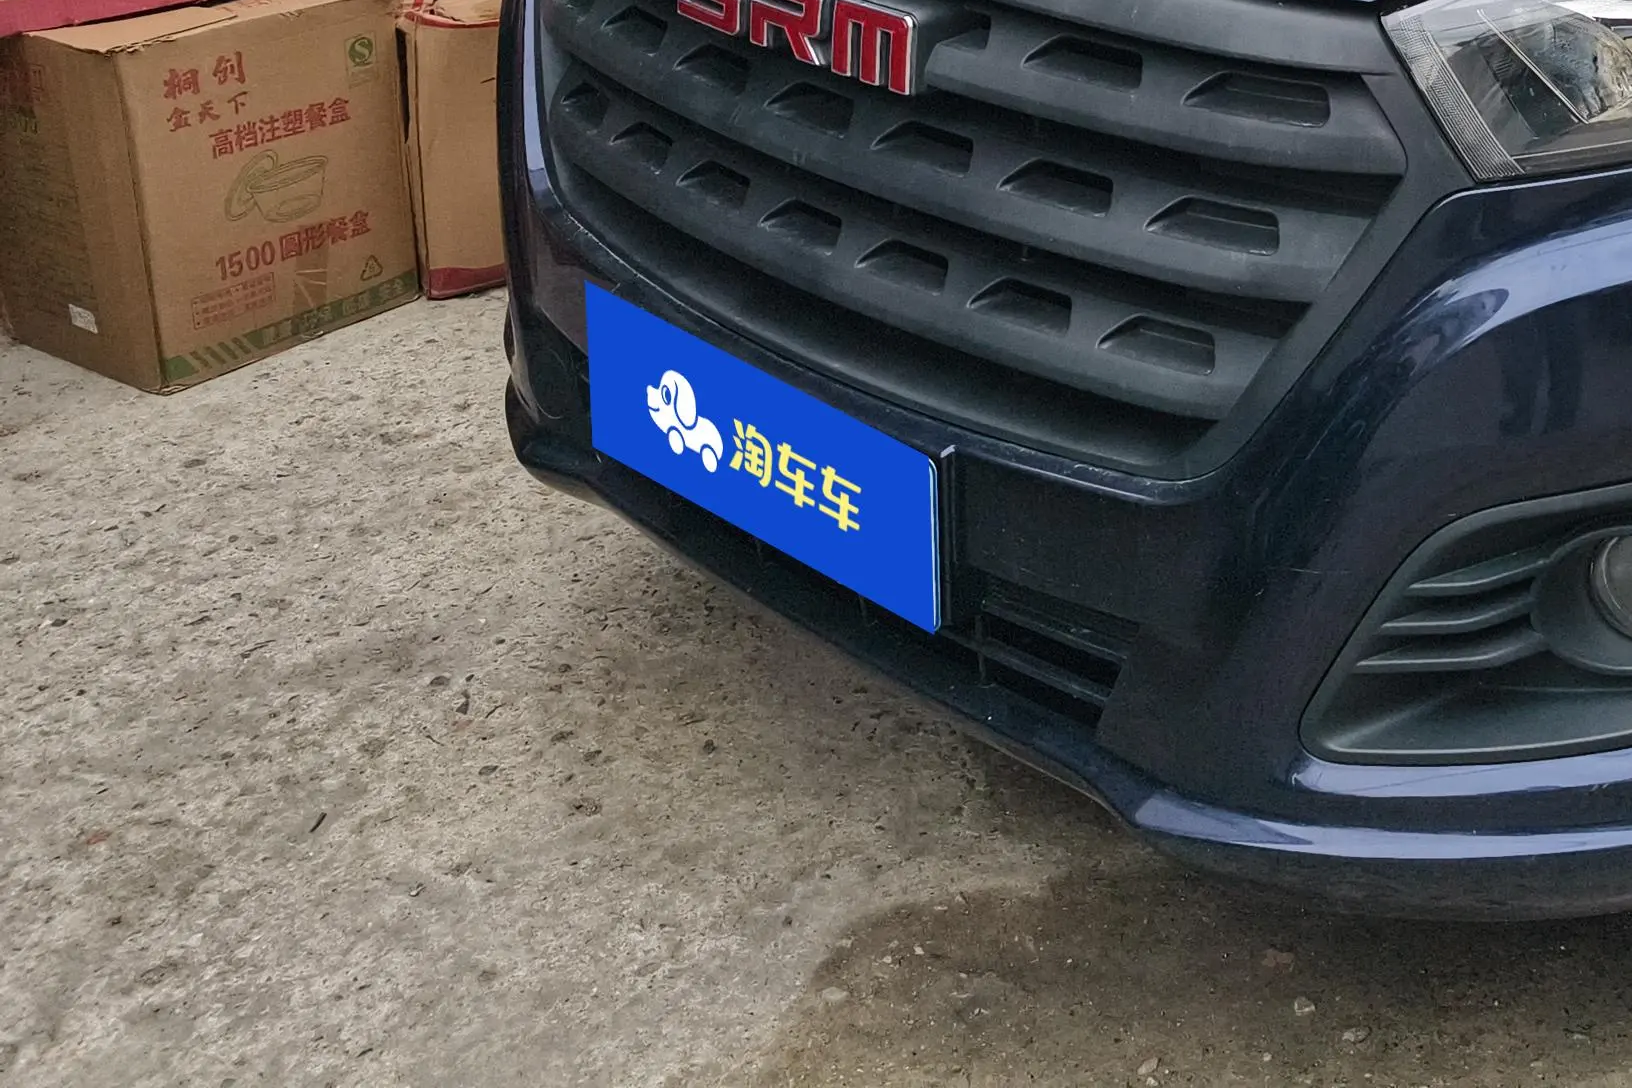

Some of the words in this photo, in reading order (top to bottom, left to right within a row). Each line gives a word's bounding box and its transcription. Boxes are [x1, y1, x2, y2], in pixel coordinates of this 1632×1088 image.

[209, 96, 352, 160] 高档注塑餐盒
